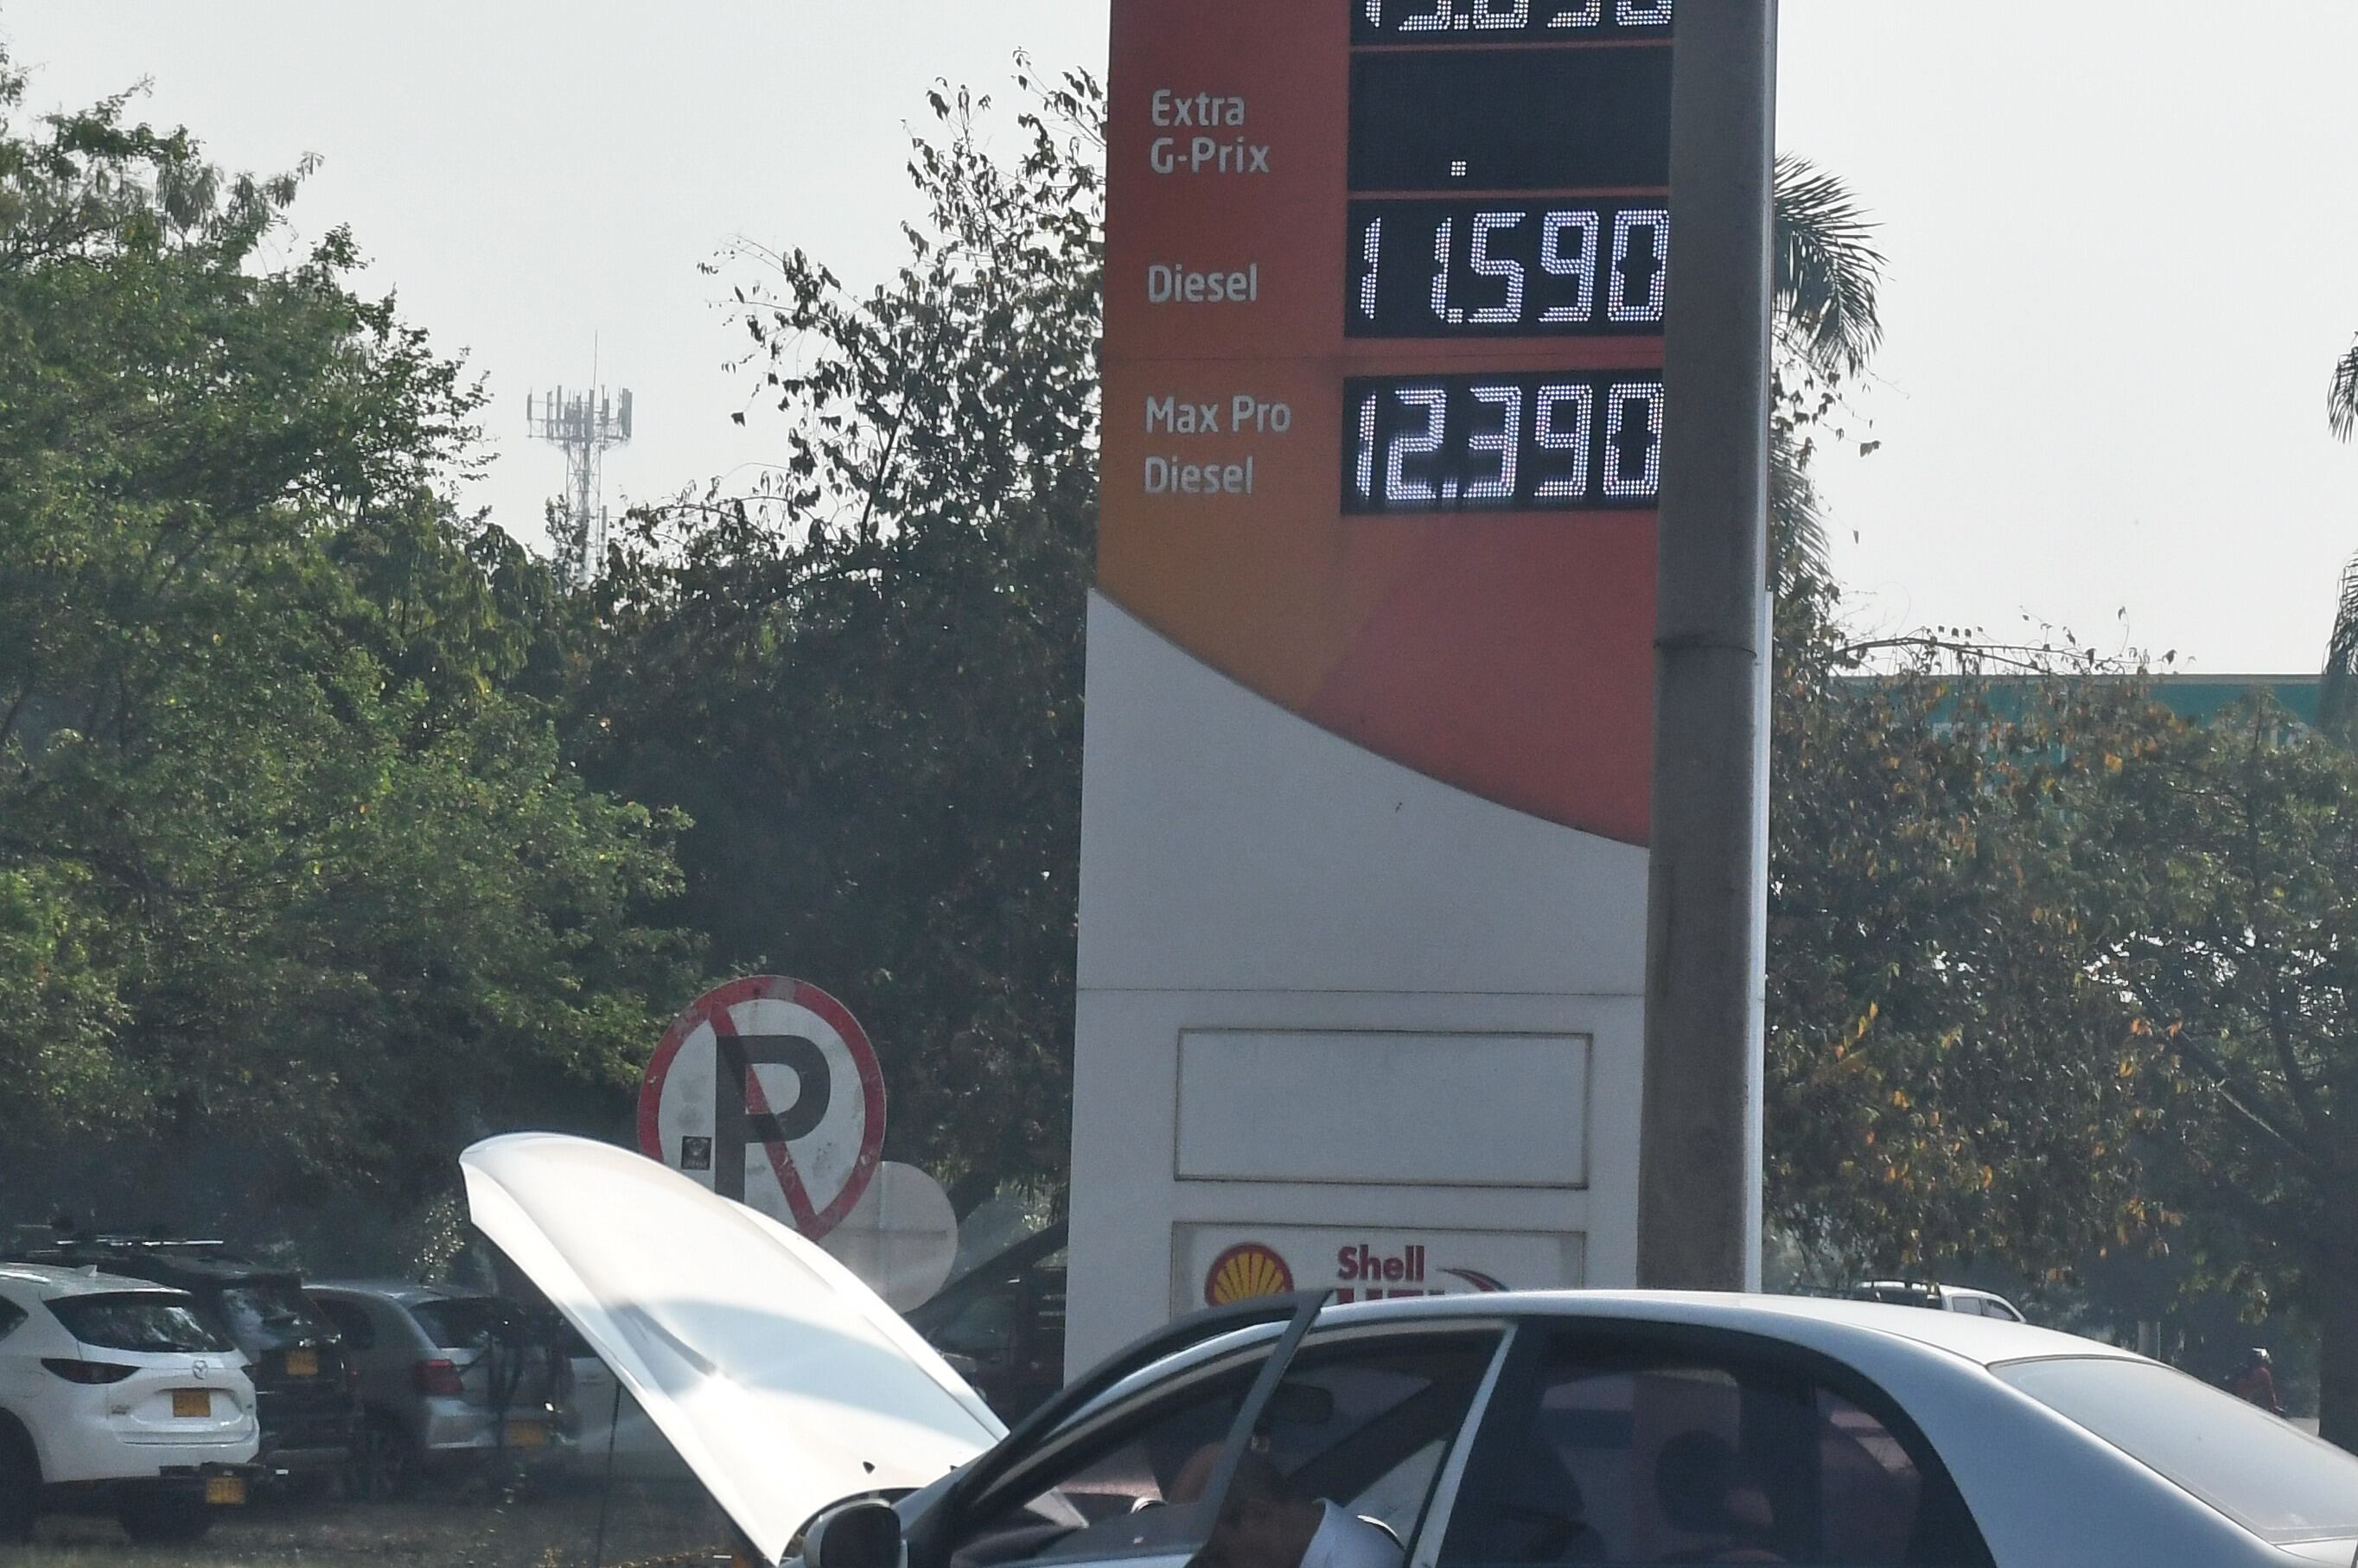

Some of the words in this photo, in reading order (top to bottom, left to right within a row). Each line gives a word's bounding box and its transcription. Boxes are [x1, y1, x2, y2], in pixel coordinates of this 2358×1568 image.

[1150, 89, 1246, 127] Extra
[1150, 137, 1270, 174] G-Prix
[1147, 264, 1258, 303] Diesel
[1360, 209, 1670, 323] 11.590
[1145, 396, 1219, 433] Max
[1232, 396, 1291, 432] Pro
[1355, 383, 1664, 500] 12.390
[1144, 456, 1252, 494] Diesel
[1337, 1245, 1424, 1281] Shell
